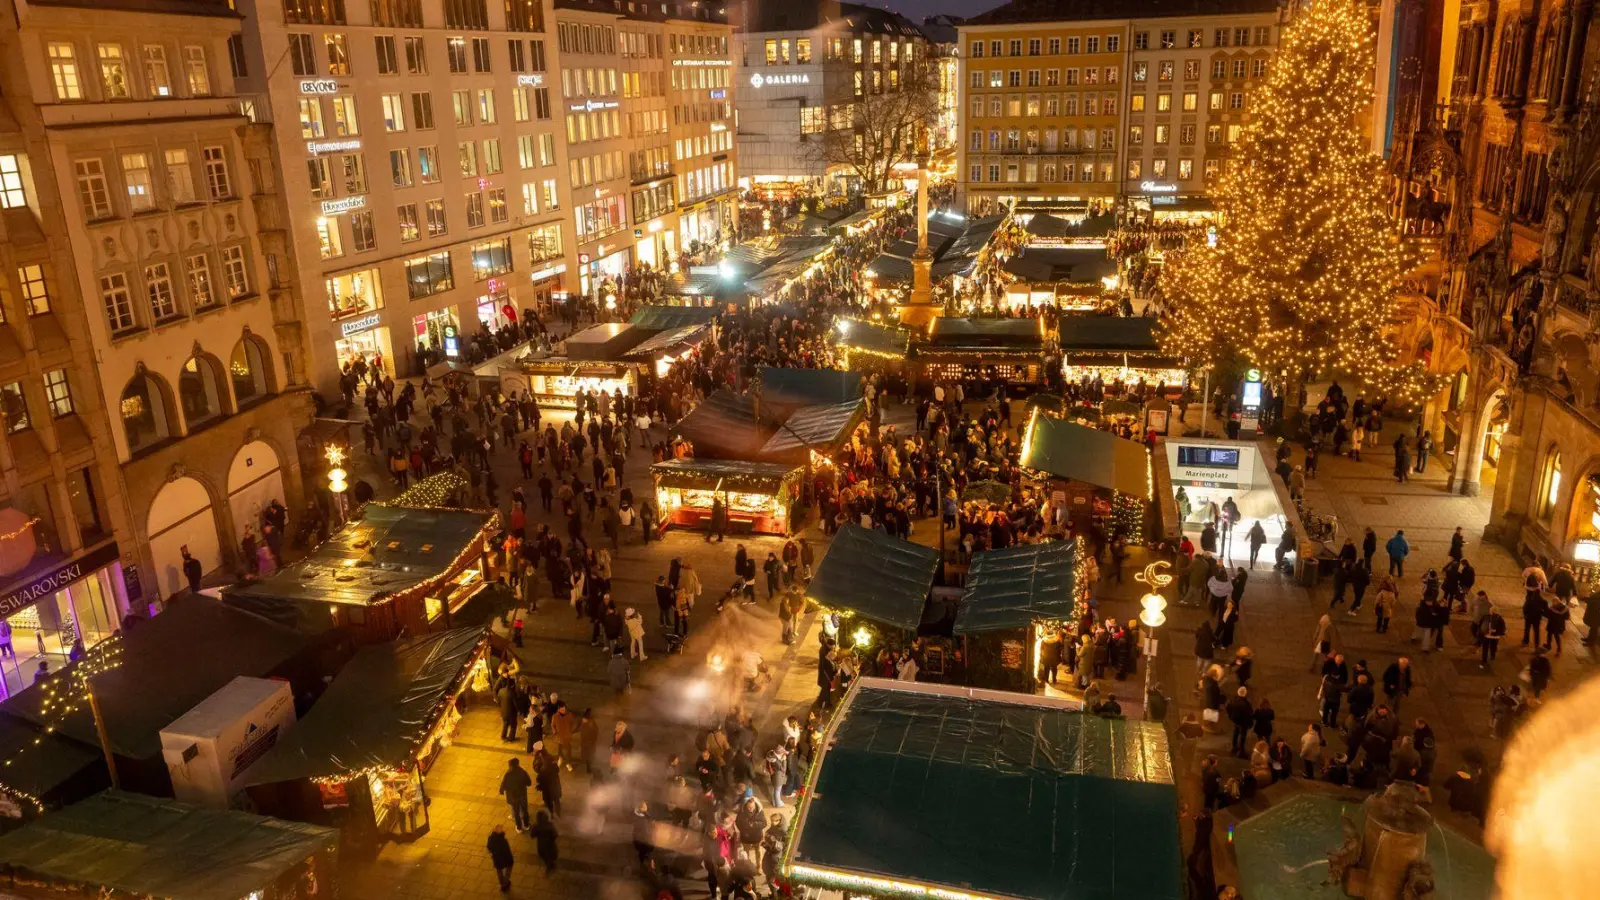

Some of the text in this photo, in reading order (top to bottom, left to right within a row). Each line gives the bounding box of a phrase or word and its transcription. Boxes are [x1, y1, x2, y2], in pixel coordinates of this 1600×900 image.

[766, 74, 809, 85] GALERIA
[302, 81, 337, 93] BEYOND
[322, 196, 366, 213] Hugendubel
[343, 315, 381, 333] Hugendubel
[445, 326, 454, 338] S
[1247, 368, 1260, 382] S
[1185, 470, 1229, 479] Marienplatz
[0, 563, 82, 614] SWAROVSKI
